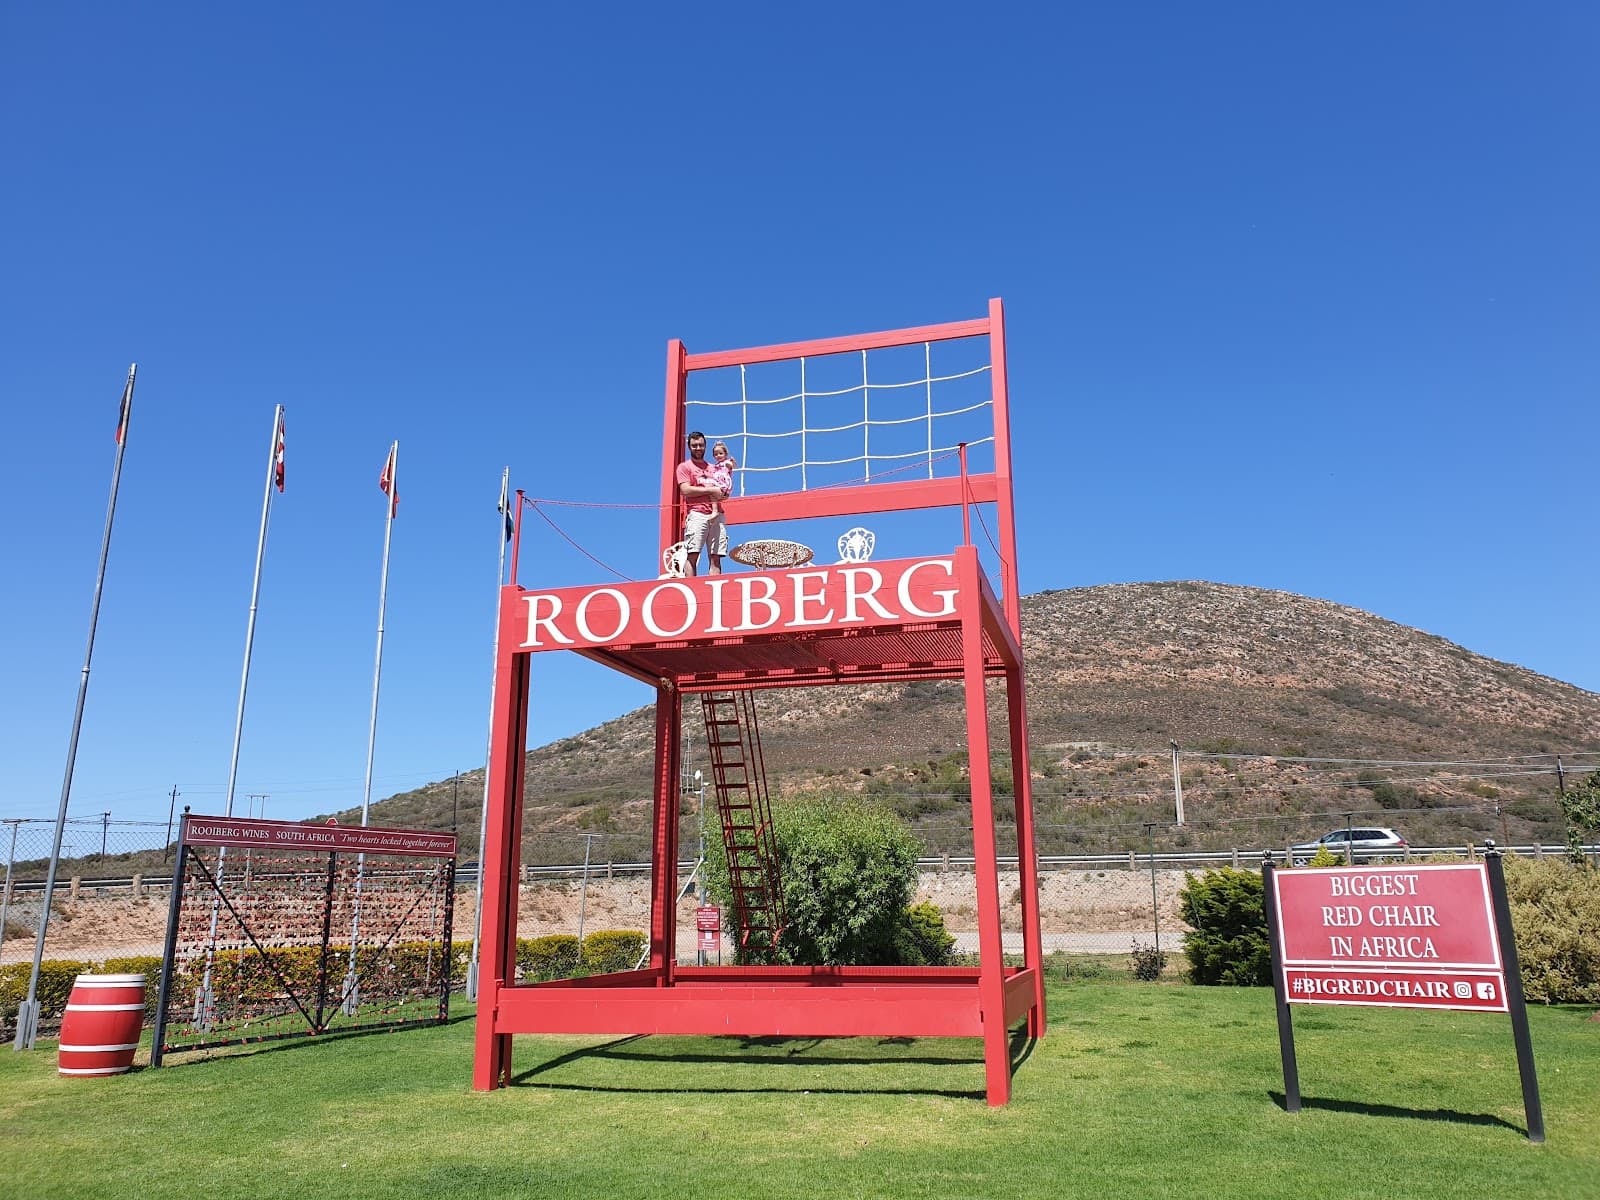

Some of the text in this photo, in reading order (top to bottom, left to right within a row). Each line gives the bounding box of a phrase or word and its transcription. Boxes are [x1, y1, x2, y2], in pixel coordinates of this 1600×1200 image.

[519, 560, 960, 648] ROOIBERG
[191, 825, 335, 843] ROOIBERG WINES SOUTH AFRICA
[358, 835, 379, 844] hearts
[380, 836, 402, 846] locked
[402, 838, 428, 849] together
[1329, 874, 1419, 897] BIGGEST
[1321, 905, 1440, 927] RED CHAIR
[1329, 936, 1440, 958] IN AFRICA
[1291, 978, 1452, 998] #BIGREDCHAIR
